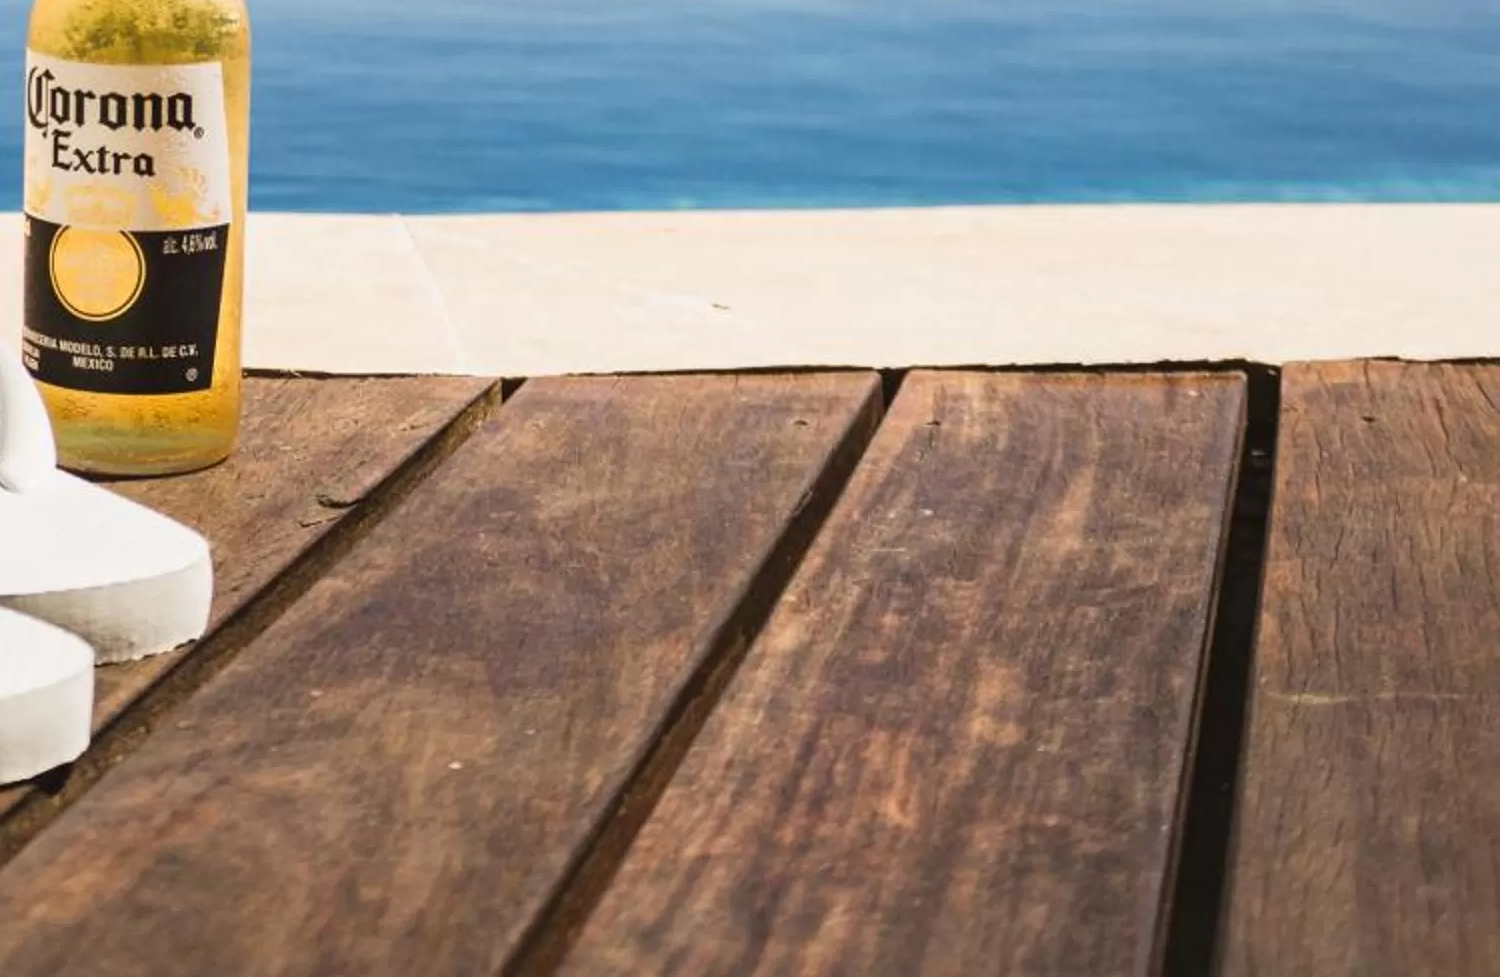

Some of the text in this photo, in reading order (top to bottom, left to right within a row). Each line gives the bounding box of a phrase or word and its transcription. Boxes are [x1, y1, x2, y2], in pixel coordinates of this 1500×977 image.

[27, 67, 196, 138] Corona
[51, 129, 157, 176] Extra
[72, 355, 114, 371] MEXICO
[120, 346, 135, 359] DE
[161, 346, 177, 358] DE
